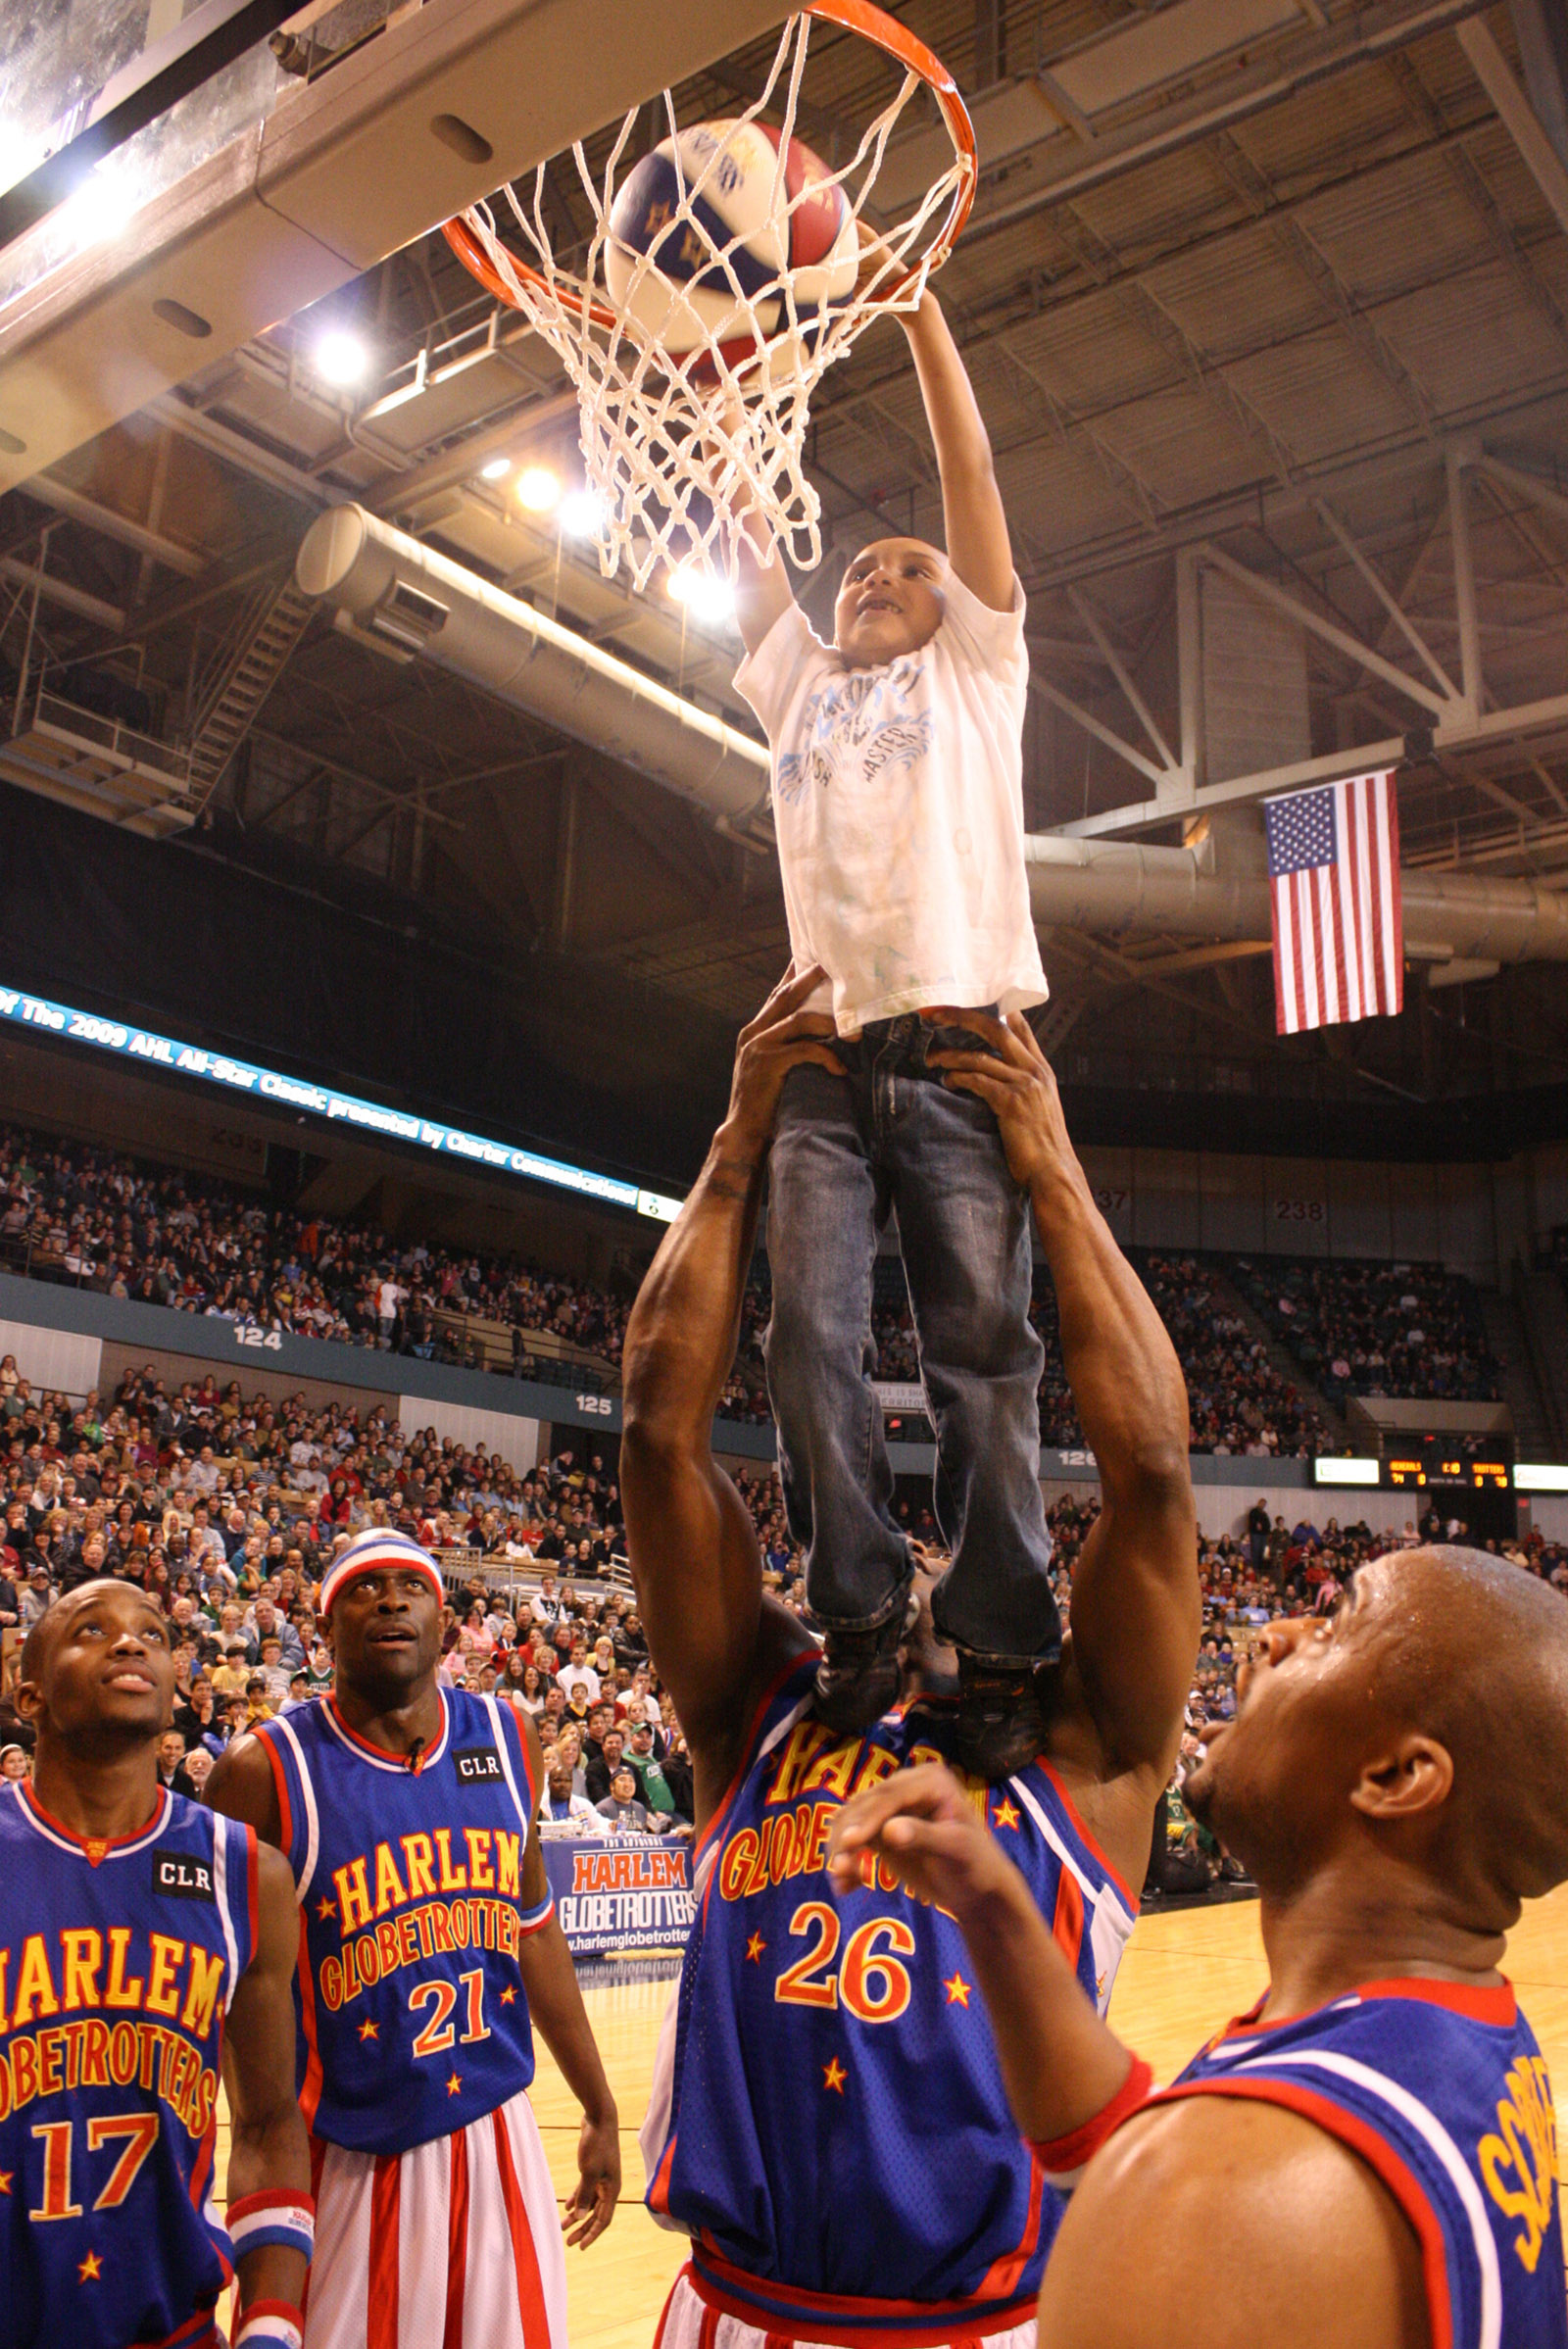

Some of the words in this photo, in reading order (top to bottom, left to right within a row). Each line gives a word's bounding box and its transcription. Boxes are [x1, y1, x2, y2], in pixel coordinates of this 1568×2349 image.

[23, 998, 66, 1030] The
[68, 1014, 128, 1048] 2009
[128, 1033, 174, 1064] AHL
[176, 1049, 259, 1088] All-Star
[260, 1074, 327, 1111] Classic
[326, 1097, 419, 1139] presented
[421, 1122, 445, 1150] by
[446, 1132, 510, 1165] Charter
[1092, 1189, 1126, 1210] 37
[1276, 1199, 1323, 1221] 238
[233, 1325, 282, 1350] 124
[576, 1395, 612, 1415] 125
[881, 1397, 925, 1407] ERRITO
[459, 1755, 500, 1777] CLR
[160, 1862, 212, 1891] CLR
[332, 1827, 521, 1939] HARLEM
[572, 1851, 688, 1894] HARLEM
[560, 1889, 698, 1934] GLOBETROTTERS
[319, 1897, 520, 2012] GLOBETROTTER
[774, 1900, 916, 2025] 26
[0, 1926, 225, 2042] ARLEM
[408, 1967, 491, 2059] 21
[28, 2111, 160, 2223] 17
